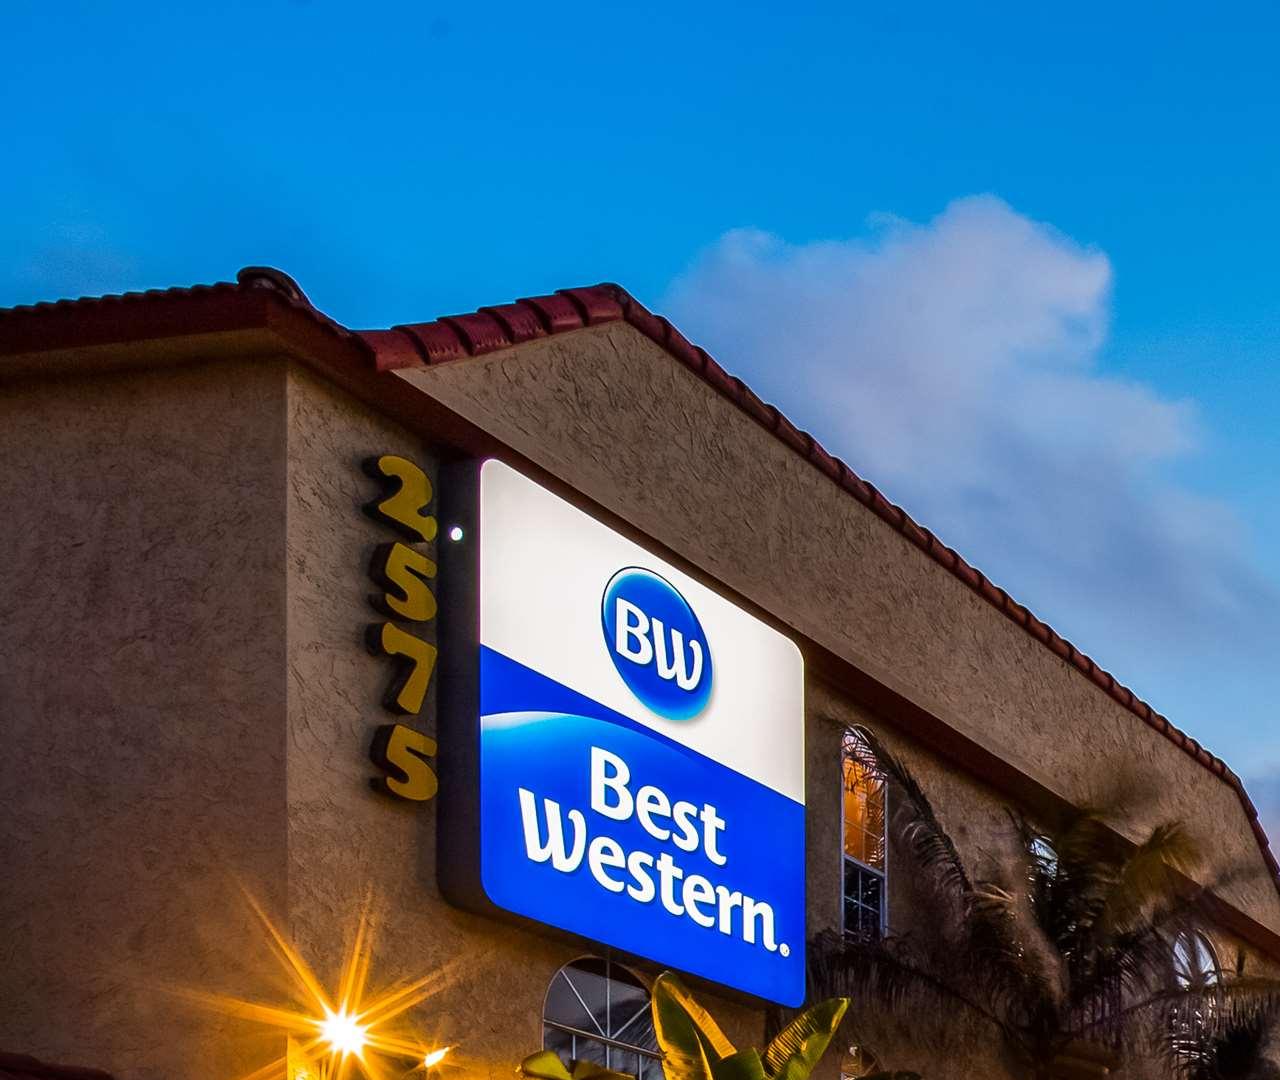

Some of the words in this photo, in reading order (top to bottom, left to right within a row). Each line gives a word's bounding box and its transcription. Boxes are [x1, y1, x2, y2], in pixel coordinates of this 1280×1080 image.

[377, 455, 439, 801] 2575
[615, 597, 703, 691] BW
[590, 745, 727, 866] Best
